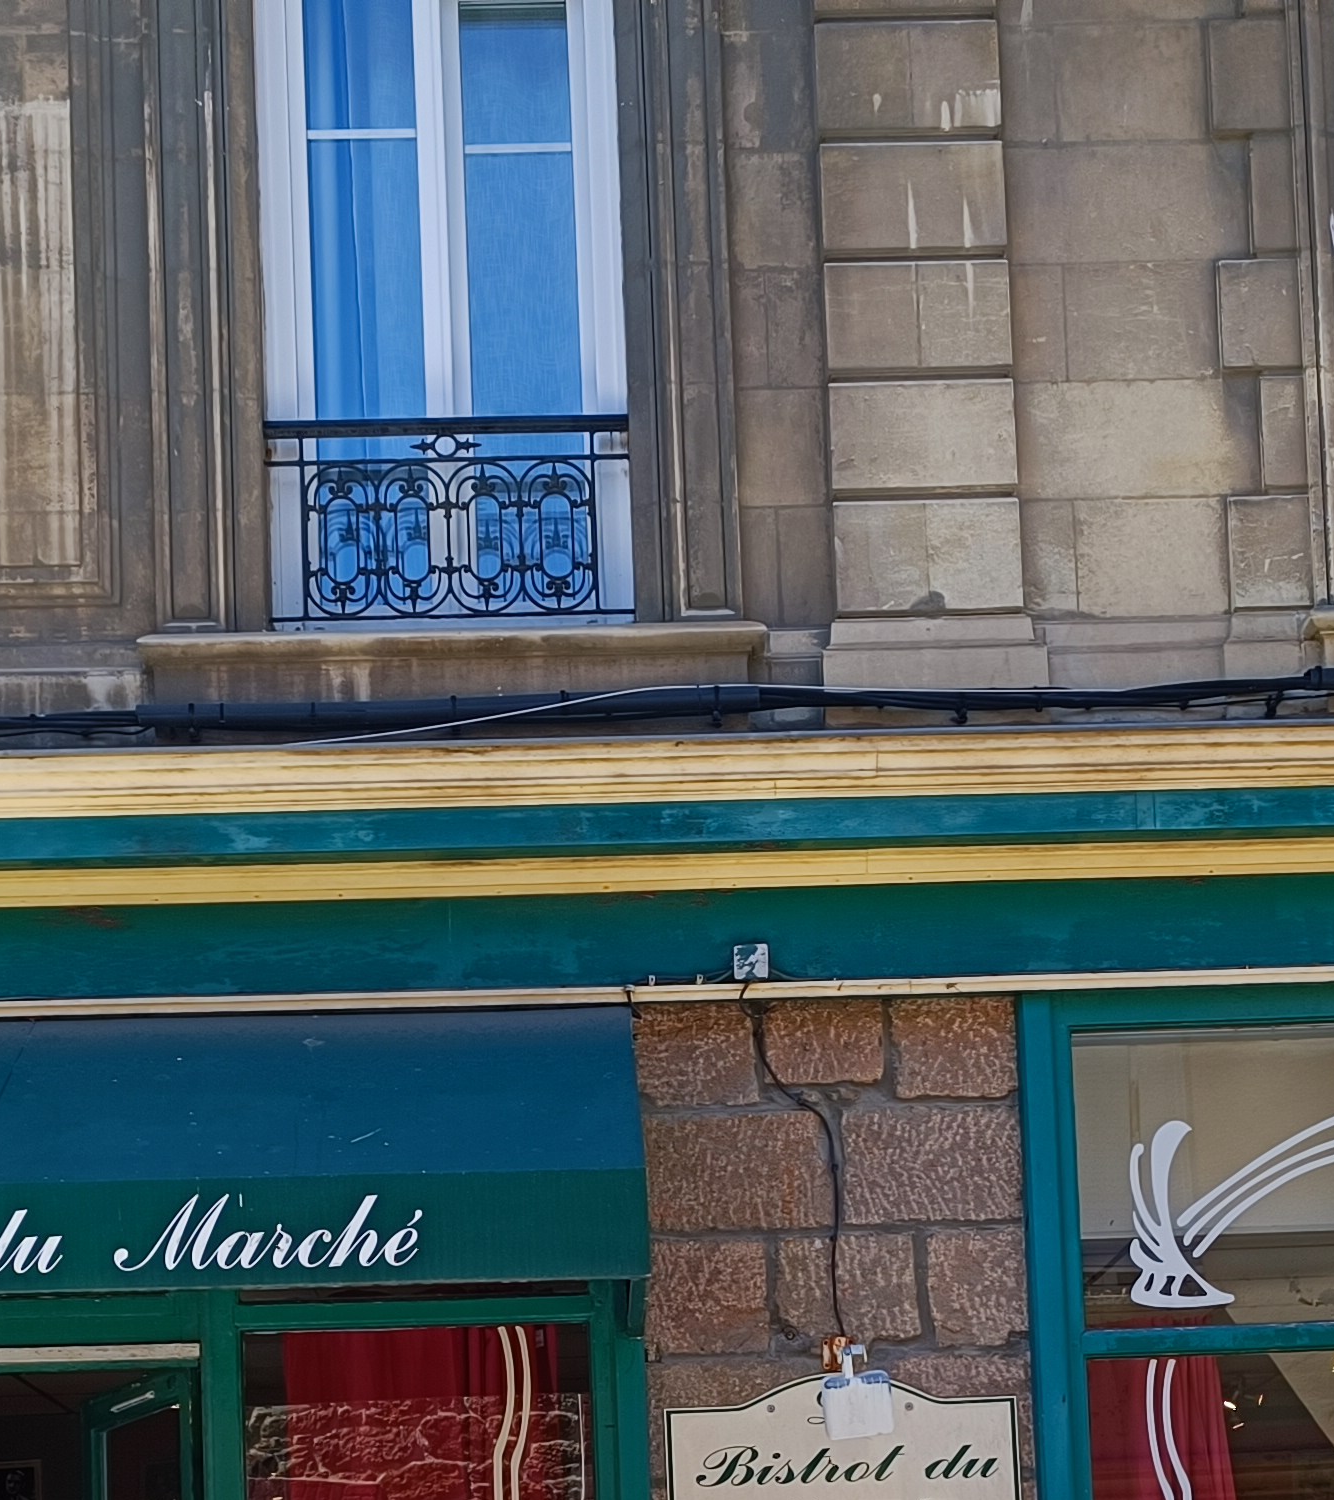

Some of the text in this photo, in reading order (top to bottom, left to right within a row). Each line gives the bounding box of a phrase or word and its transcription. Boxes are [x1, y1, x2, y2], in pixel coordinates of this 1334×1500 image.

[113, 1193, 423, 1272] Marché
[695, 1444, 999, 1488] Bistrot du
